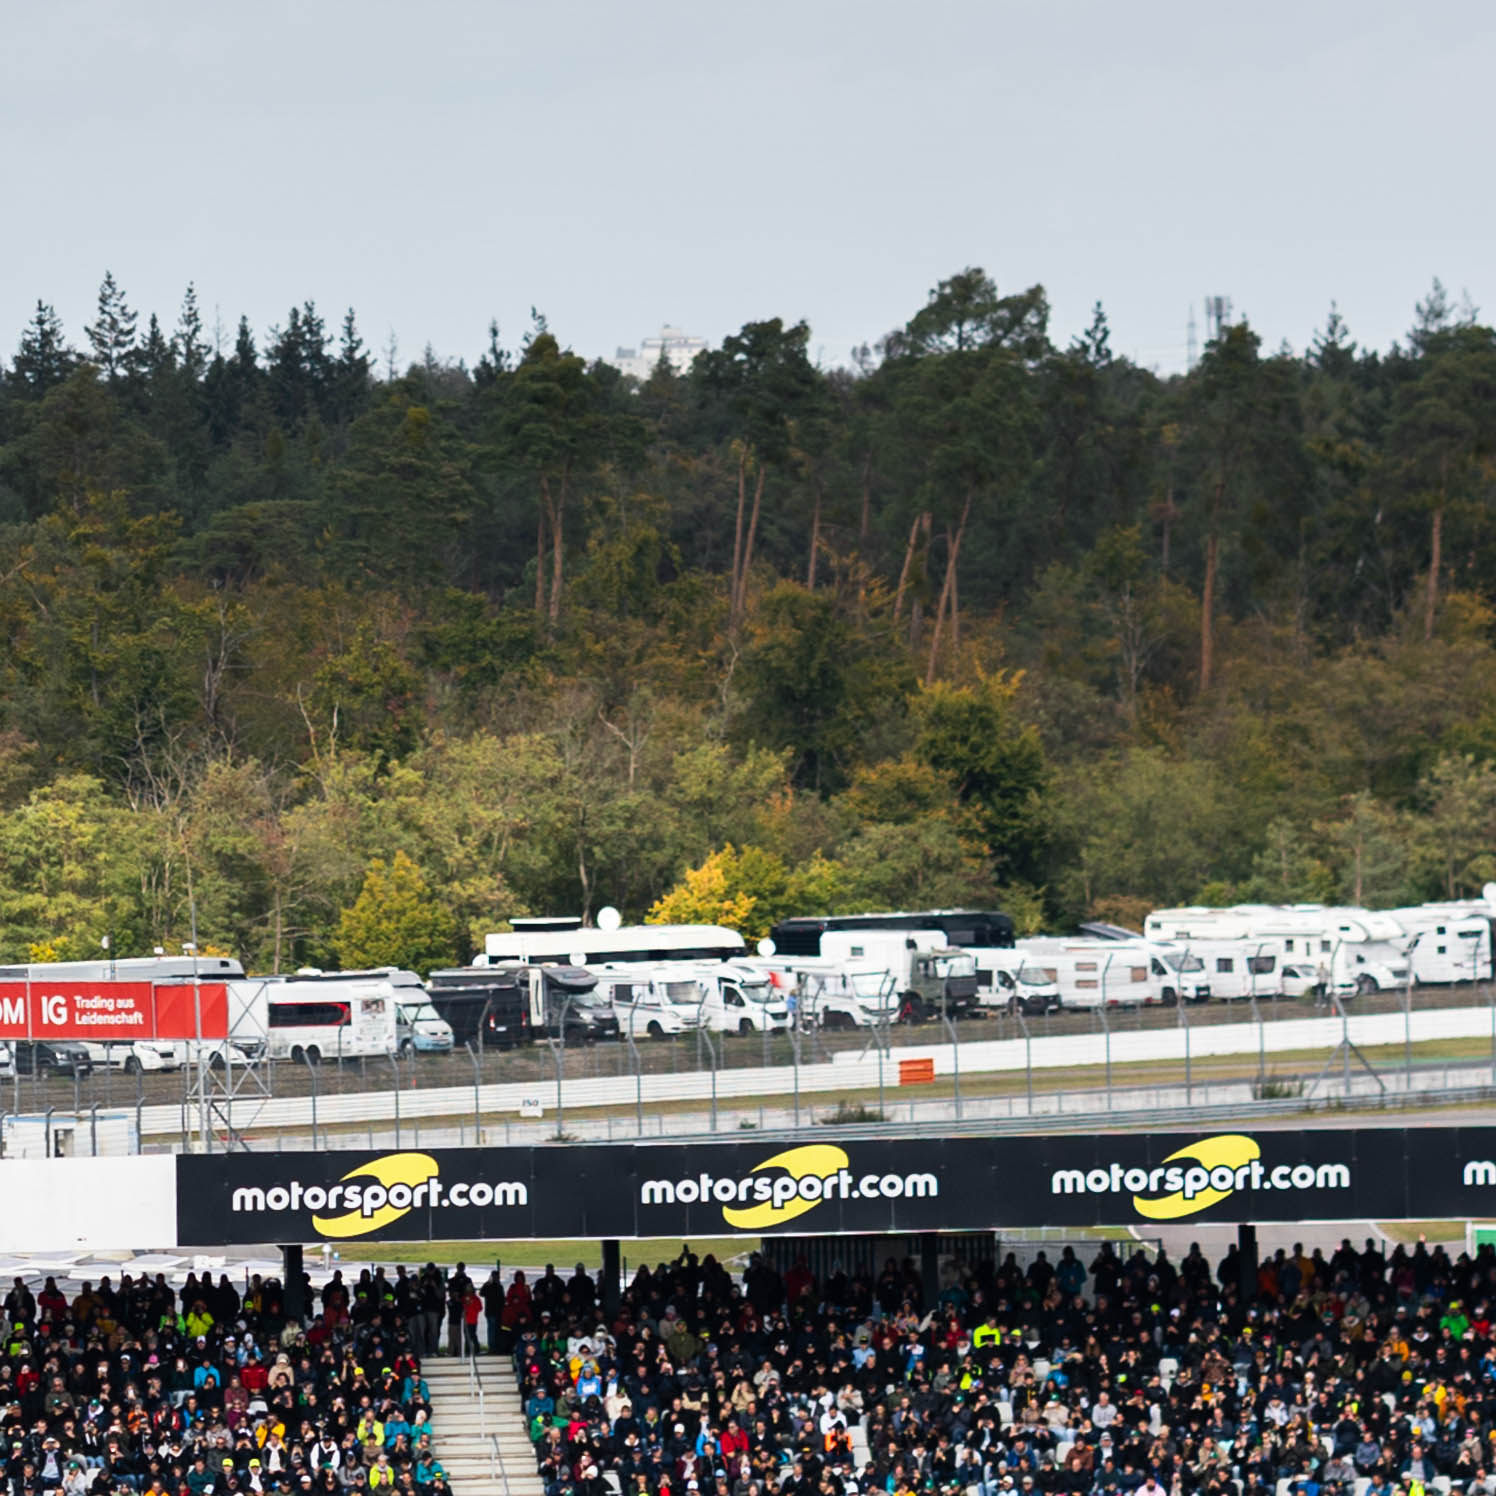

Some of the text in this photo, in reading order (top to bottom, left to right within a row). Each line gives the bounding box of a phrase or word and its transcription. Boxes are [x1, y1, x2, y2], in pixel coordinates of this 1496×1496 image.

[41, 996, 67, 1025] IG
[74, 996, 134, 1010] Trading aus
[75, 1010, 143, 1025] Leidenschaft
[642, 1171, 938, 1208] motorsport.com
[1052, 1160, 1350, 1198] motorsport.com
[233, 1179, 528, 1216] motorsport.com
